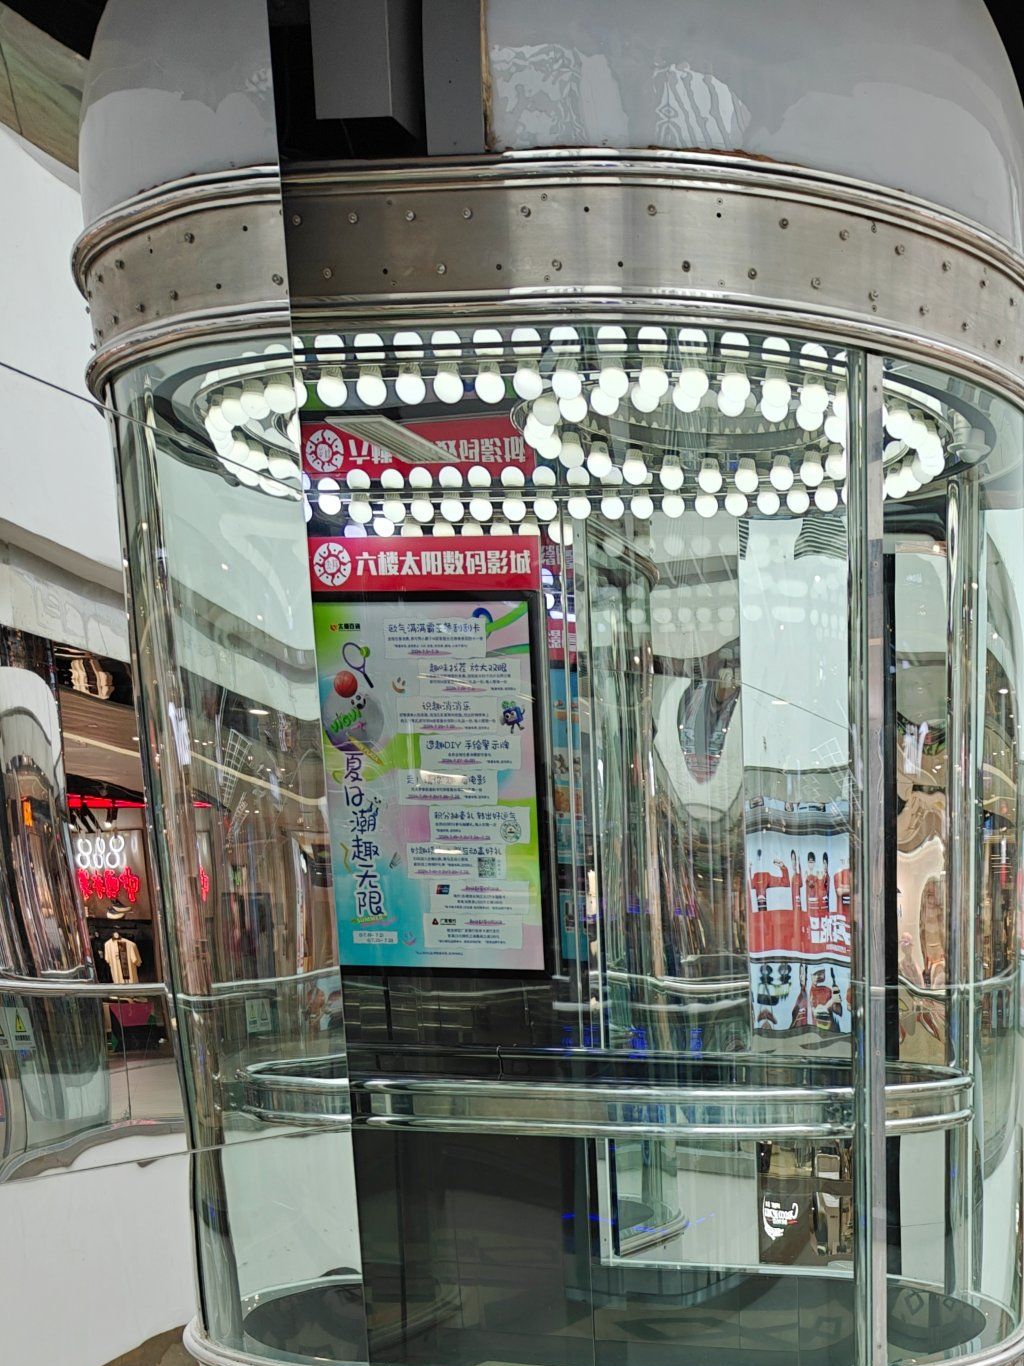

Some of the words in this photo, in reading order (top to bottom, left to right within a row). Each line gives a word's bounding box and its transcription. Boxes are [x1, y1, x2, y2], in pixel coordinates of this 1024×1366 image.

[355, 550, 531, 576] 六楼太阳数码影城
